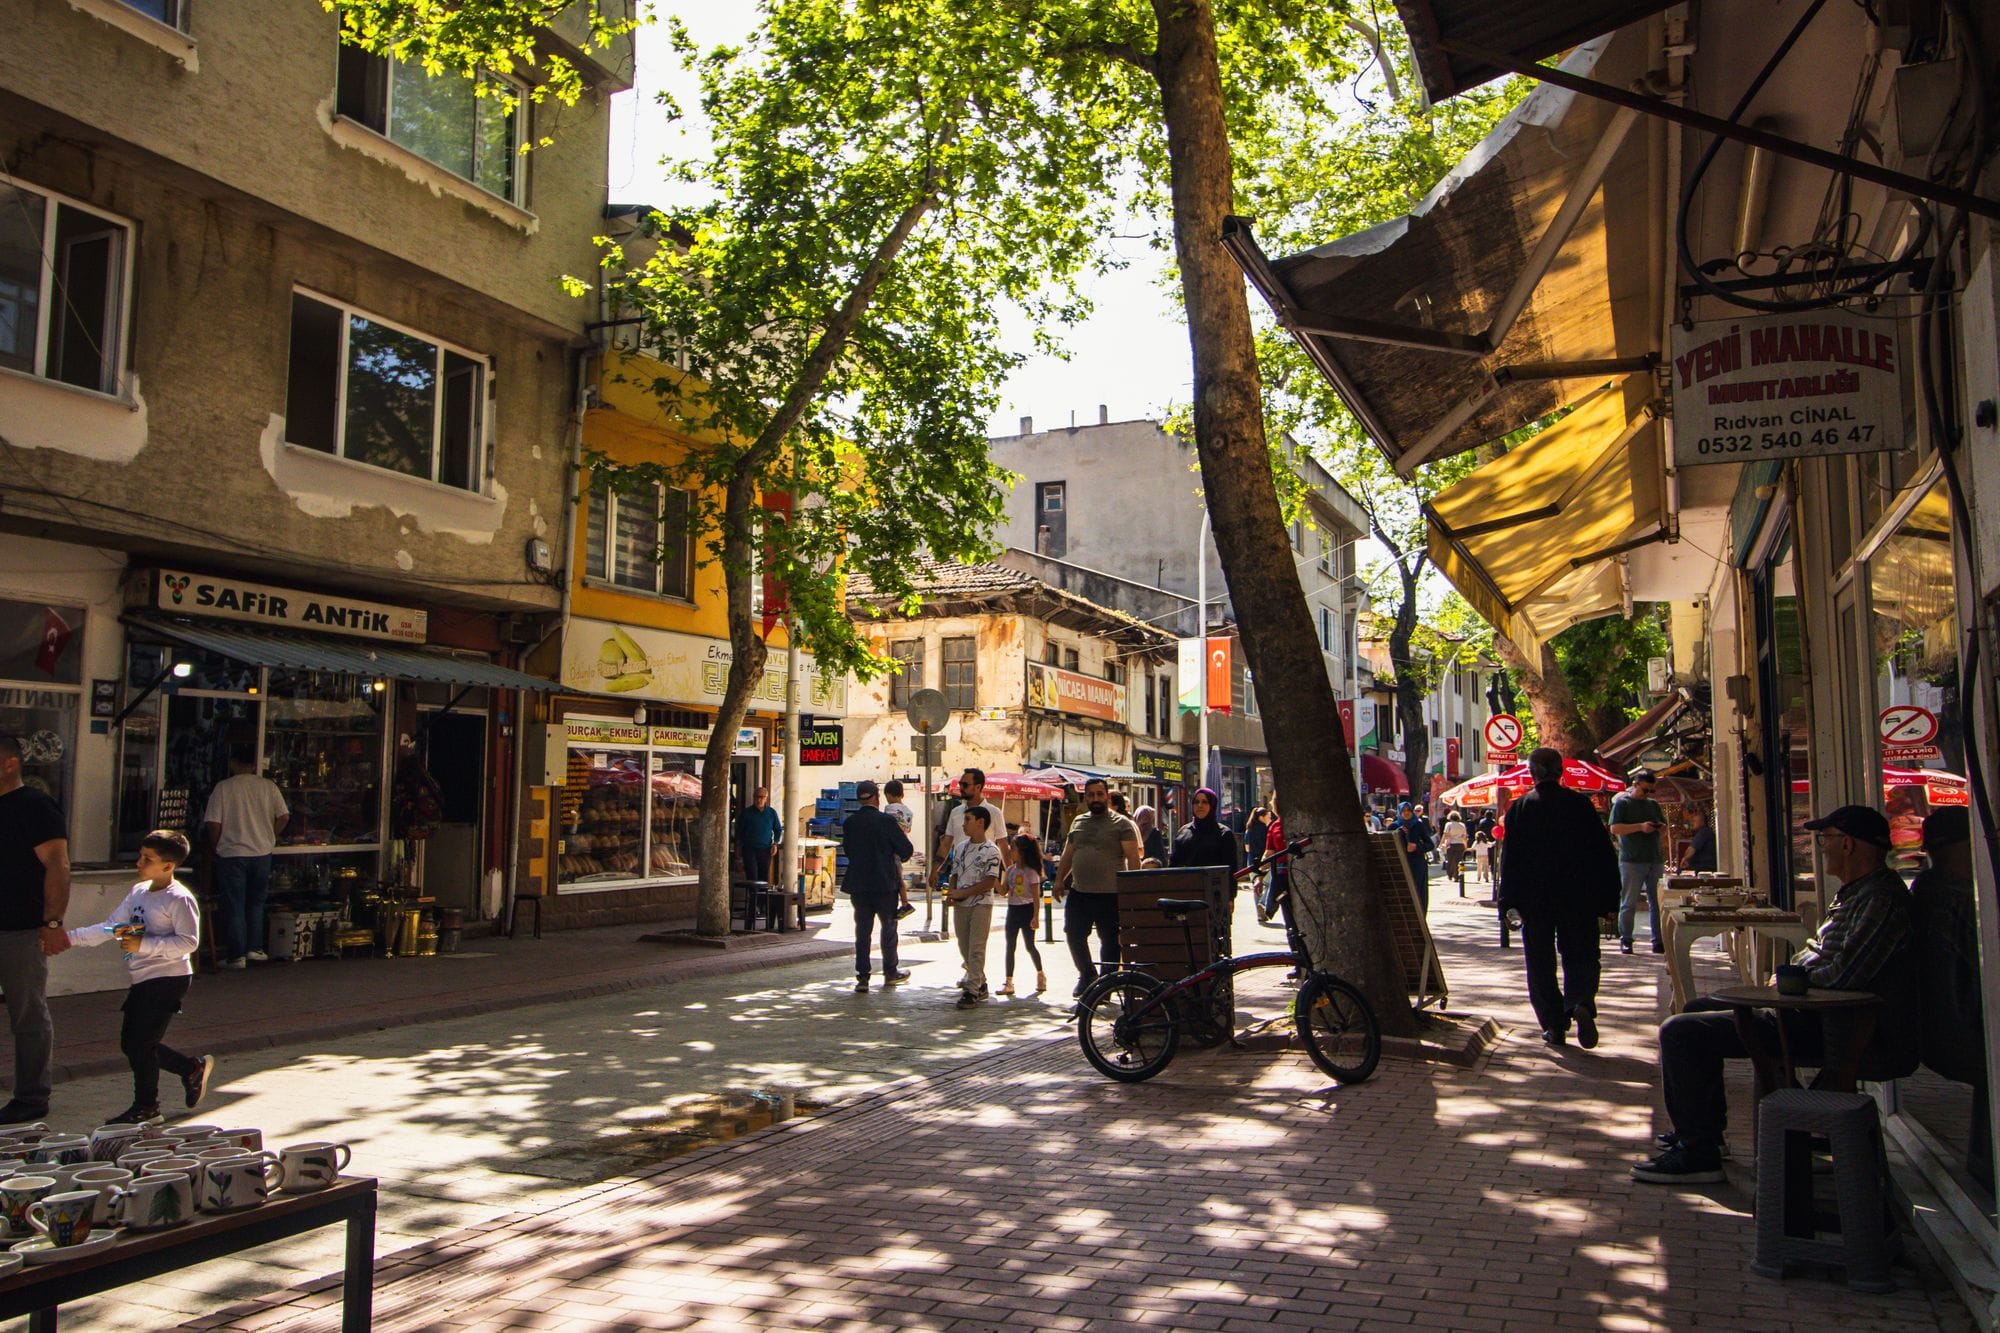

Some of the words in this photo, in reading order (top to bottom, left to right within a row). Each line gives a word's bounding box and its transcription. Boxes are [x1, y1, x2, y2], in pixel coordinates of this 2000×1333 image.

[1674, 325, 1742, 390] YENİ
[1750, 324, 1895, 373] MAHALLE
[1708, 368, 1860, 405] MUHTARLIĞI
[1714, 412, 1783, 431] Rıdvan
[1790, 406, 1856, 425] CİNAL
[1698, 435, 1753, 454] 0532
[1761, 431, 1802, 450] 540
[1811, 428, 1839, 446] 46
[1847, 425, 1876, 442] 47
